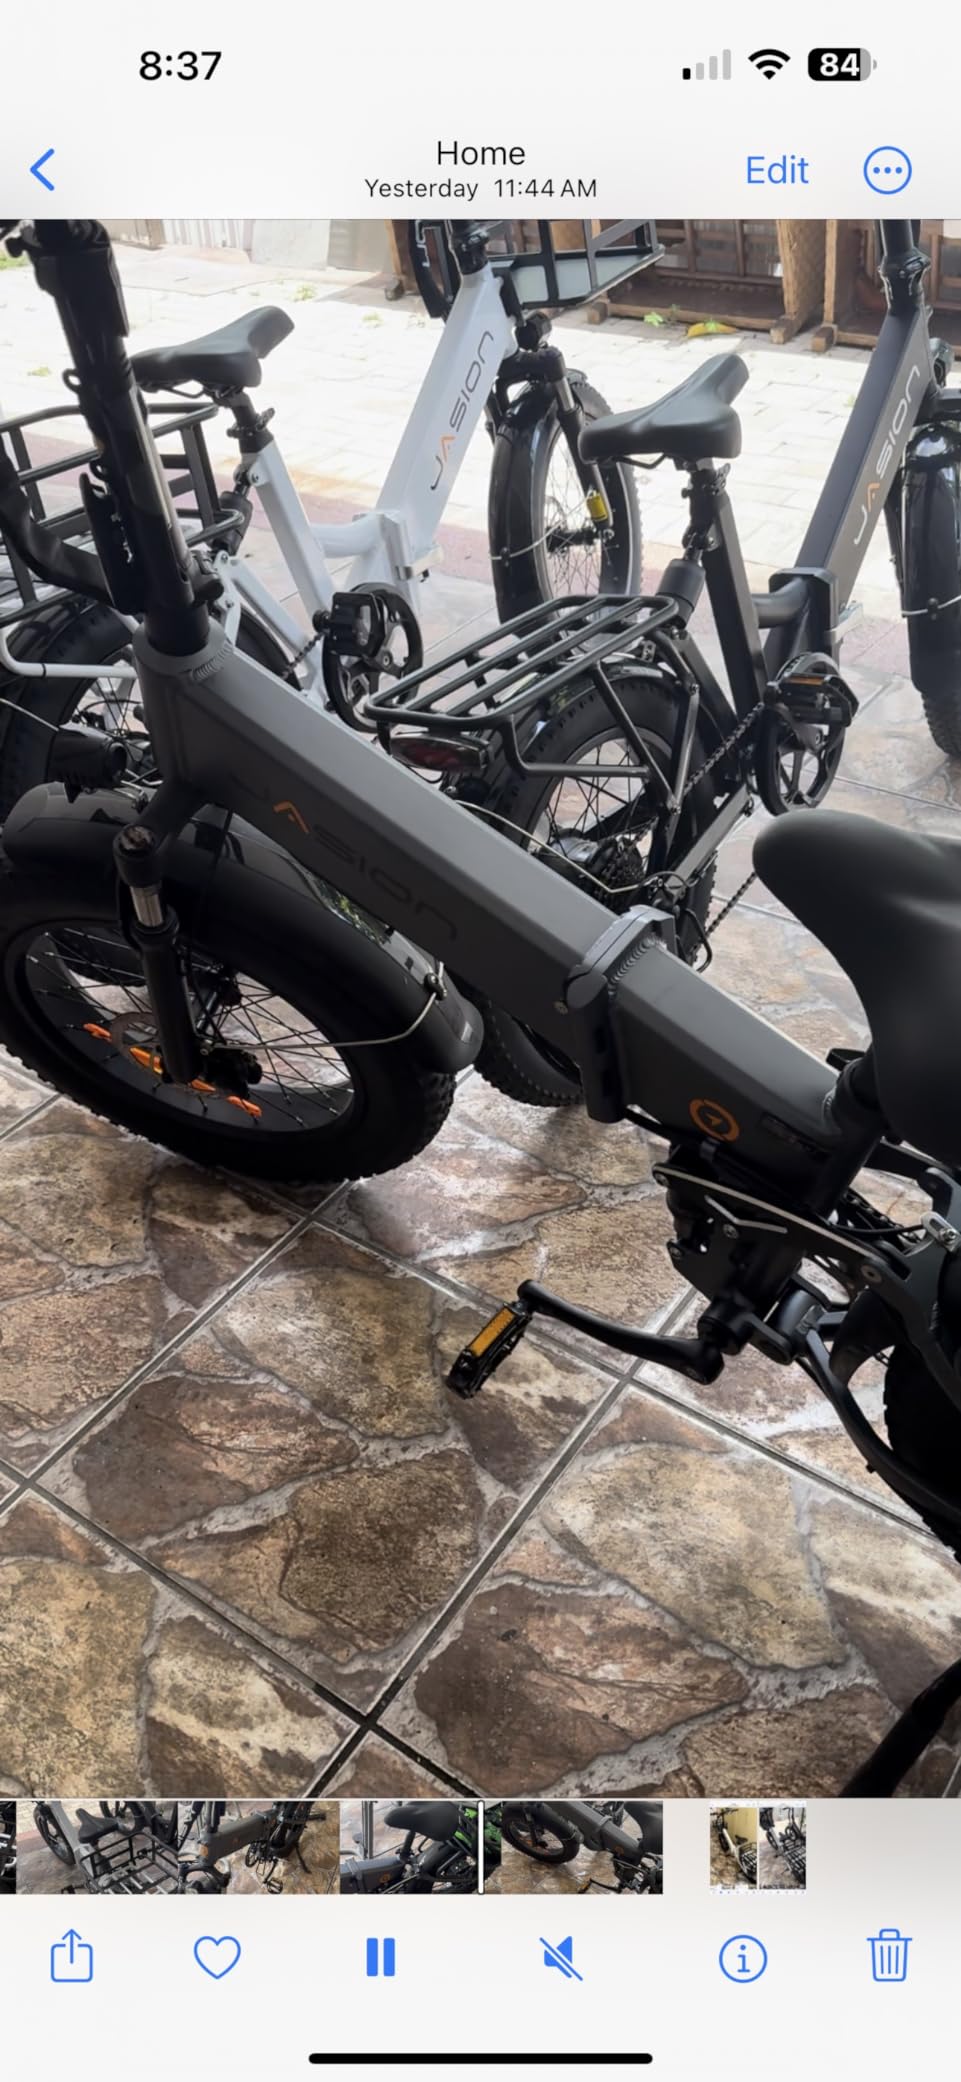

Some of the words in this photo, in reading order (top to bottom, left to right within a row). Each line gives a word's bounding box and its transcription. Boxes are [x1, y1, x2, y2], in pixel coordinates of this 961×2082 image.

[139, 50, 222, 81] 8:37
[820, 52, 860, 77] 84
[437, 140, 526, 166] Home
[746, 154, 809, 185] Edit
[364, 178, 479, 202] Yesterday
[494, 178, 556, 198] 11:44
[560, 178, 598, 198] AM
